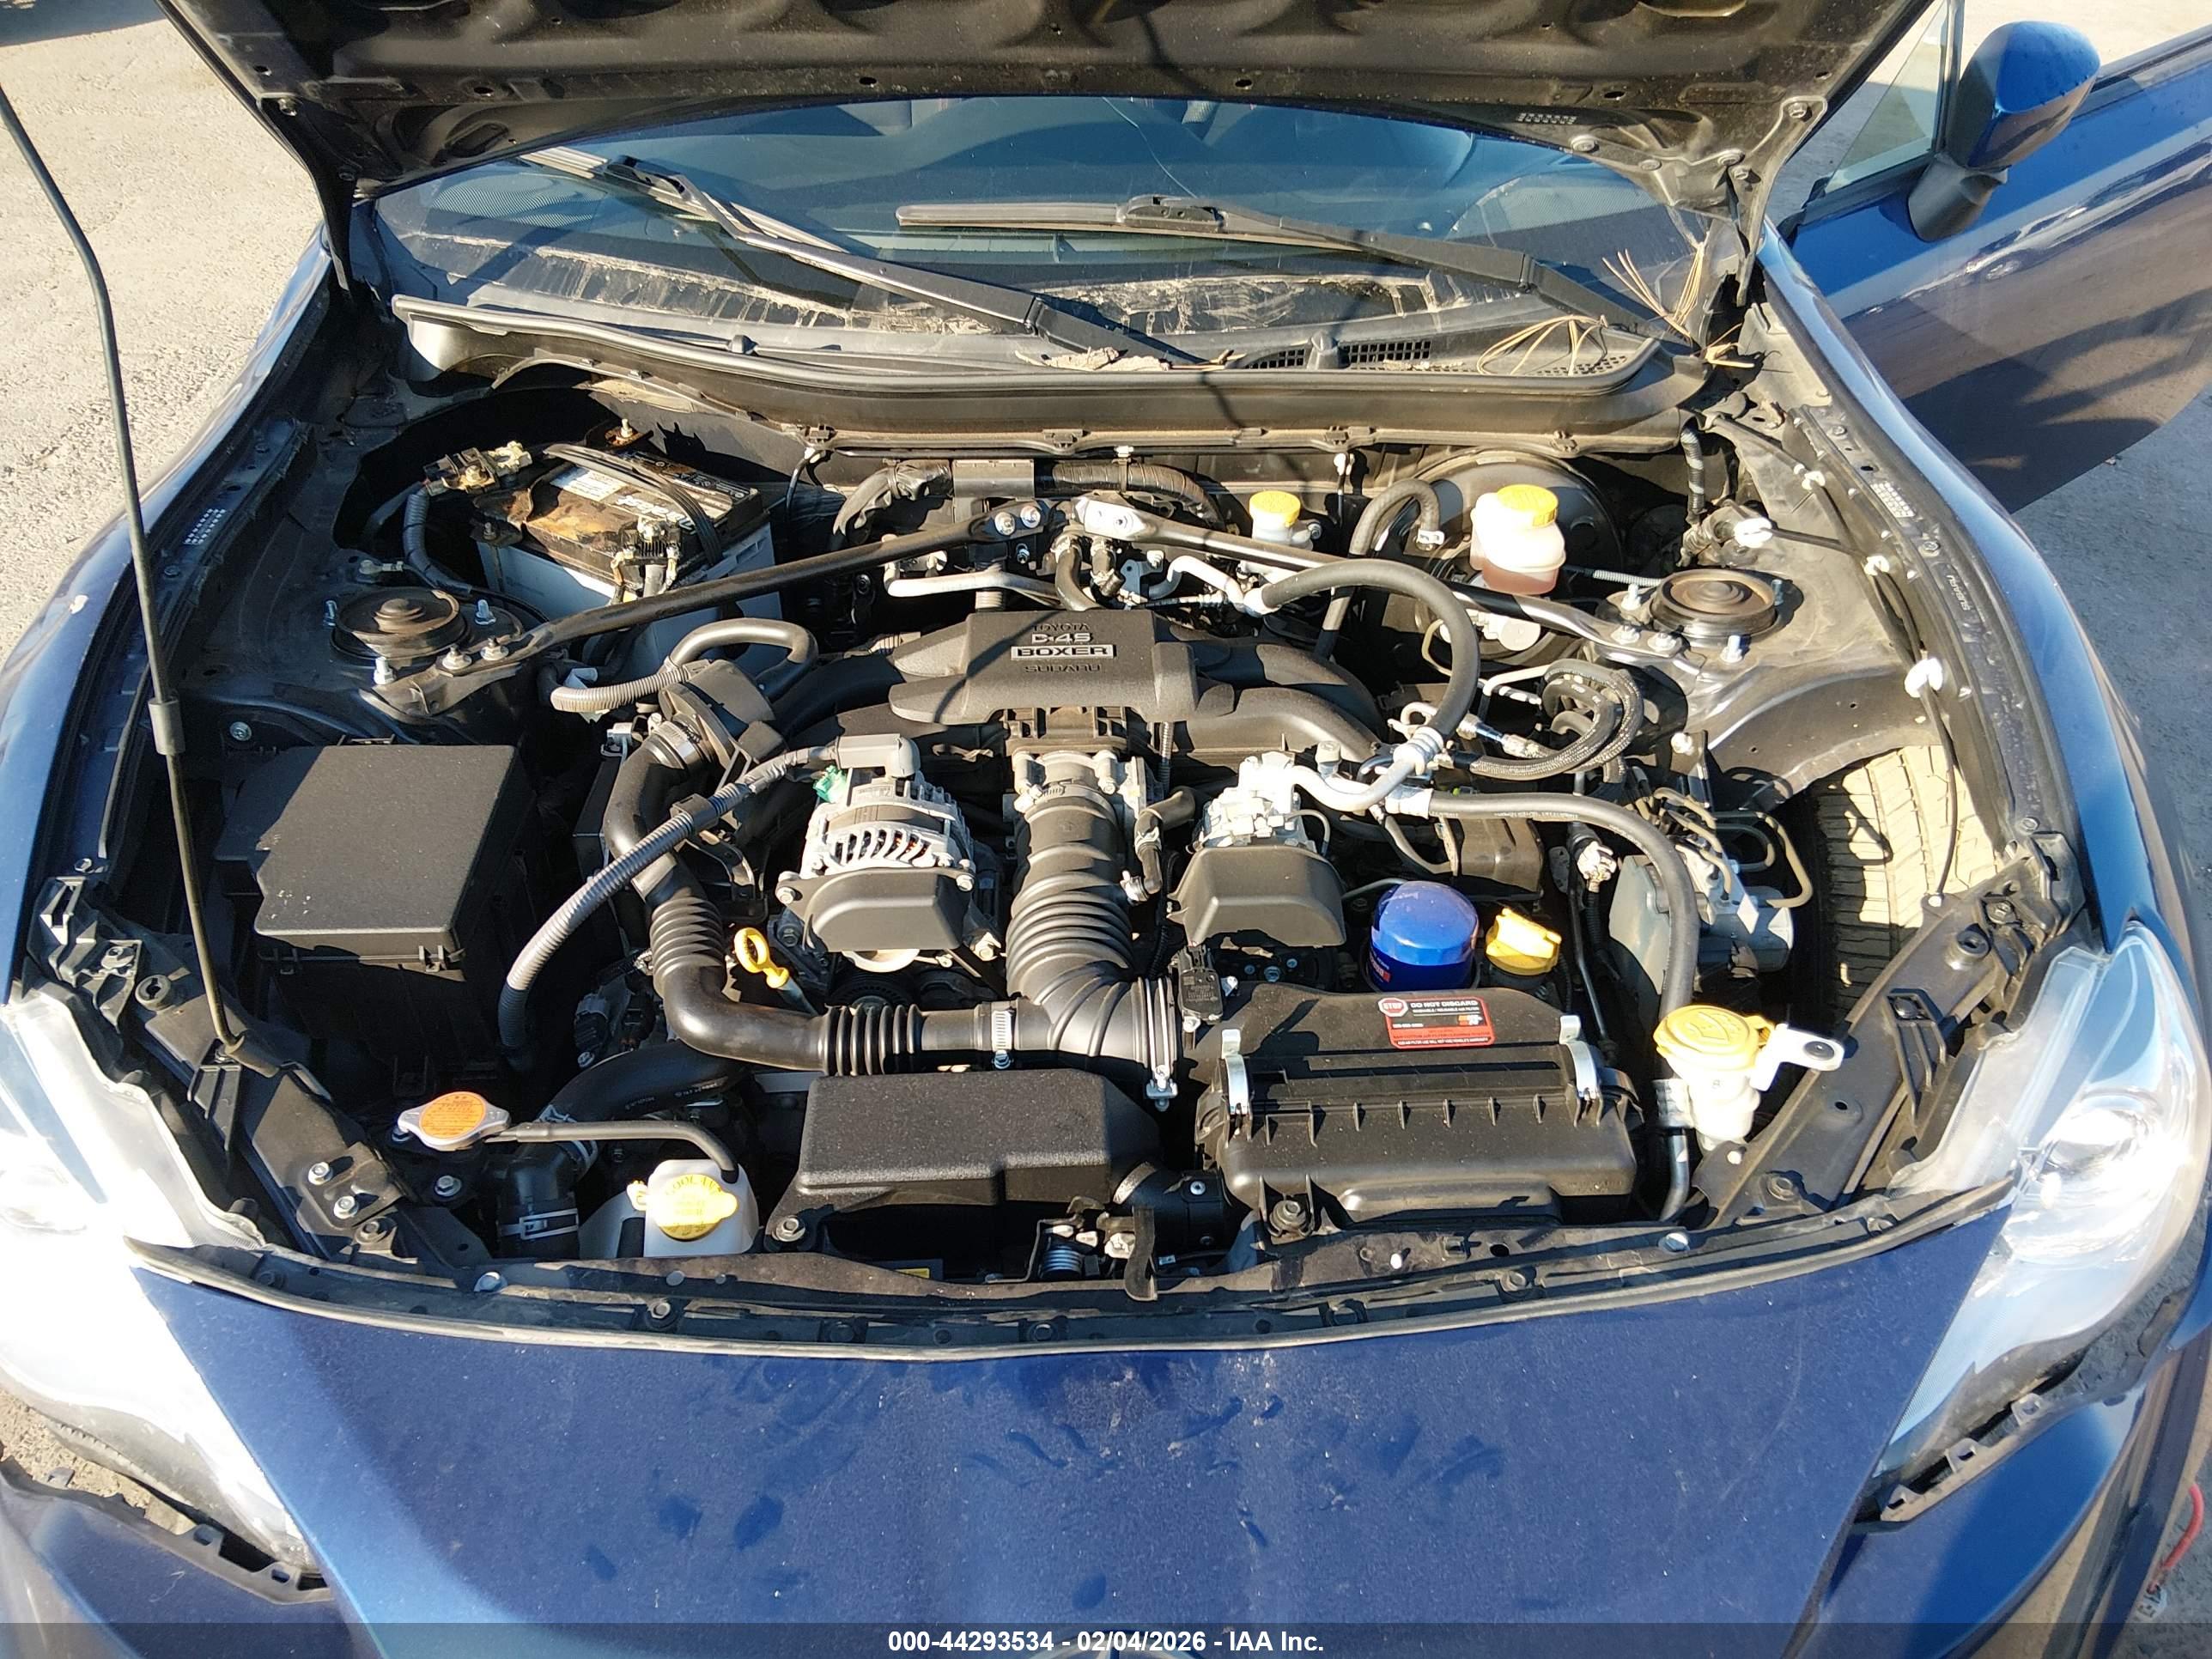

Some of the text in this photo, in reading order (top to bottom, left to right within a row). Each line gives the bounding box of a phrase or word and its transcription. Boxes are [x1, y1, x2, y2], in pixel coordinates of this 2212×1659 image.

[1946, 574, 1971, 611] SUBARU
[1032, 623, 1091, 632] TOYOTA
[1017, 646, 1108, 658] BOXER
[1024, 663, 1102, 673] SUBARU
